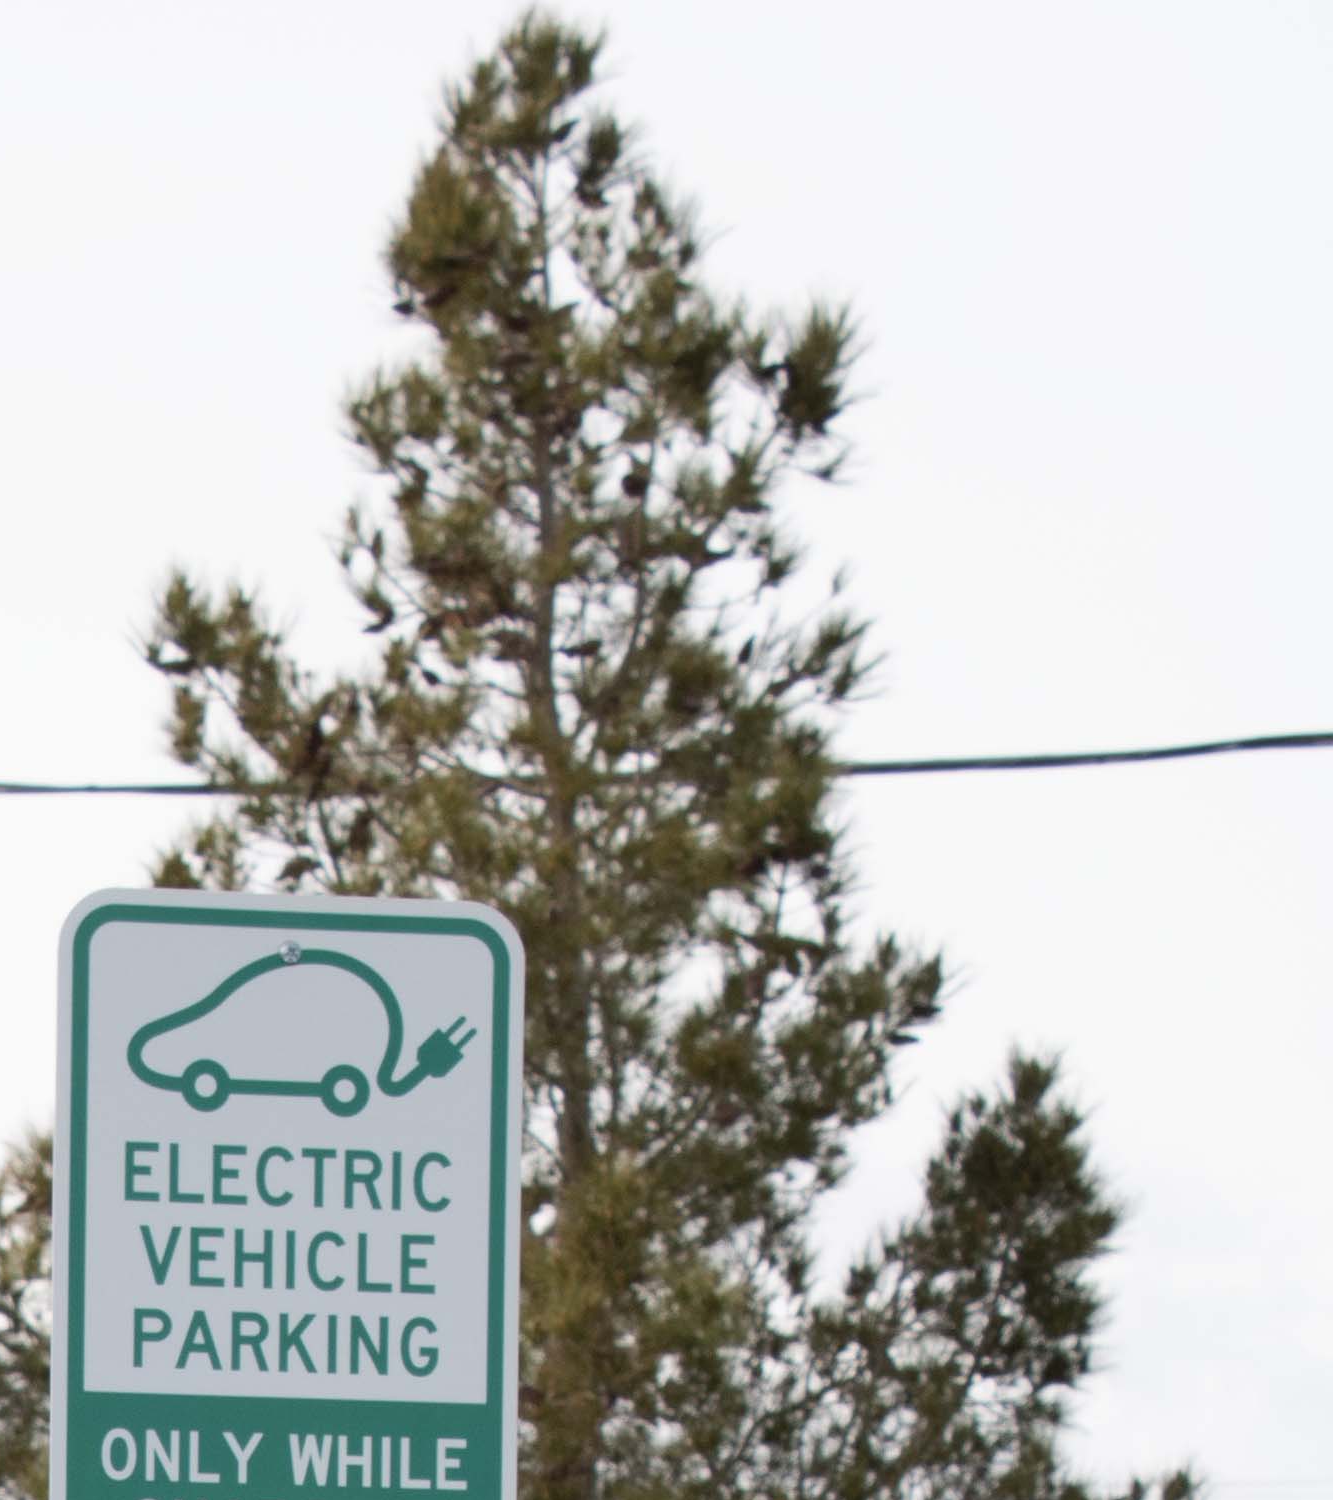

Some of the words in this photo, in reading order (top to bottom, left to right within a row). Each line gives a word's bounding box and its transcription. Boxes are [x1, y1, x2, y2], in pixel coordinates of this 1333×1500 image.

[124, 1141, 452, 1213] ELECTRIC
[139, 1224, 436, 1295] VEHICLE
[132, 1308, 440, 1378] PARKING
[101, 1427, 264, 1484] ONLY
[289, 1433, 468, 1491] WHILE
